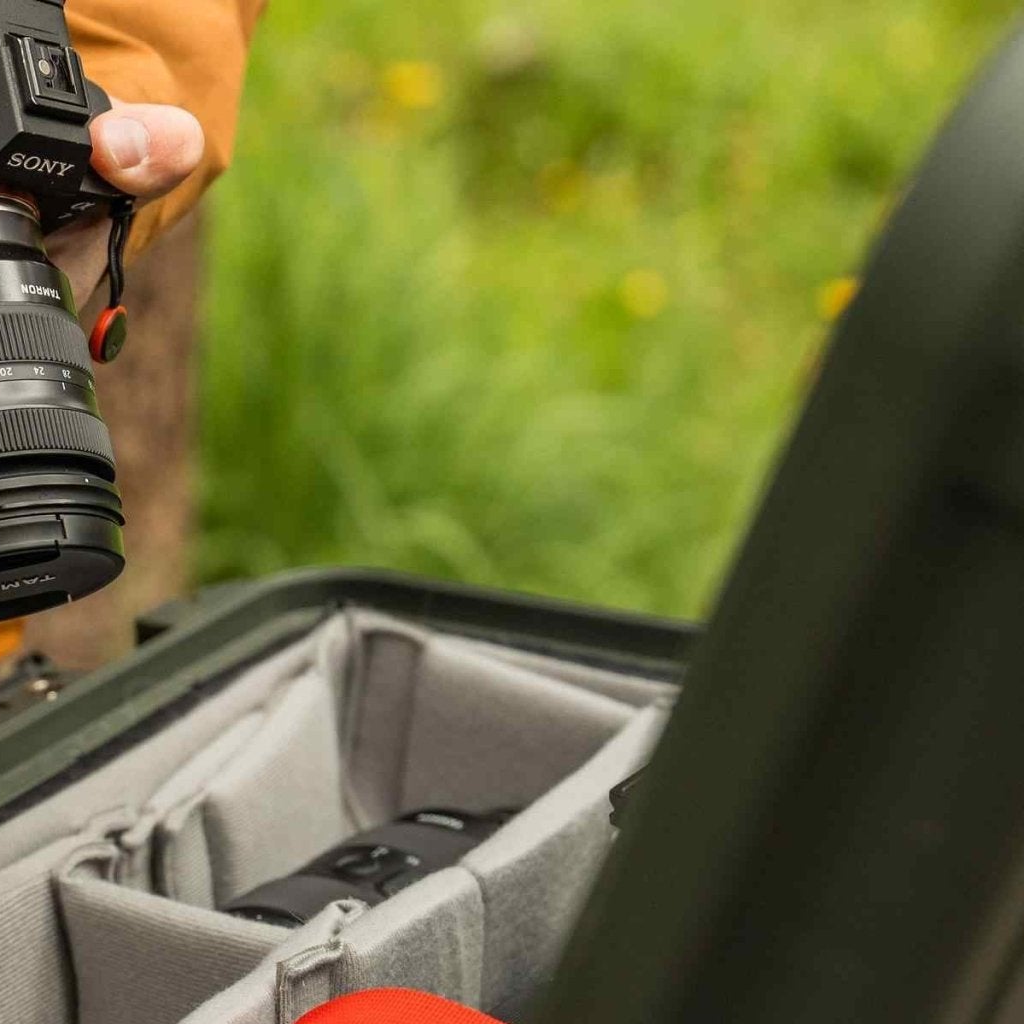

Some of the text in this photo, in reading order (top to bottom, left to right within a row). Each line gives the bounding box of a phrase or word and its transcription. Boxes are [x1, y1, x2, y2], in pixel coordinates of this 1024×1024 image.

[7, 152, 75, 176] SONY
[21, 283, 61, 300] TAMRON
[0, 366, 72, 379] 28 24 20
